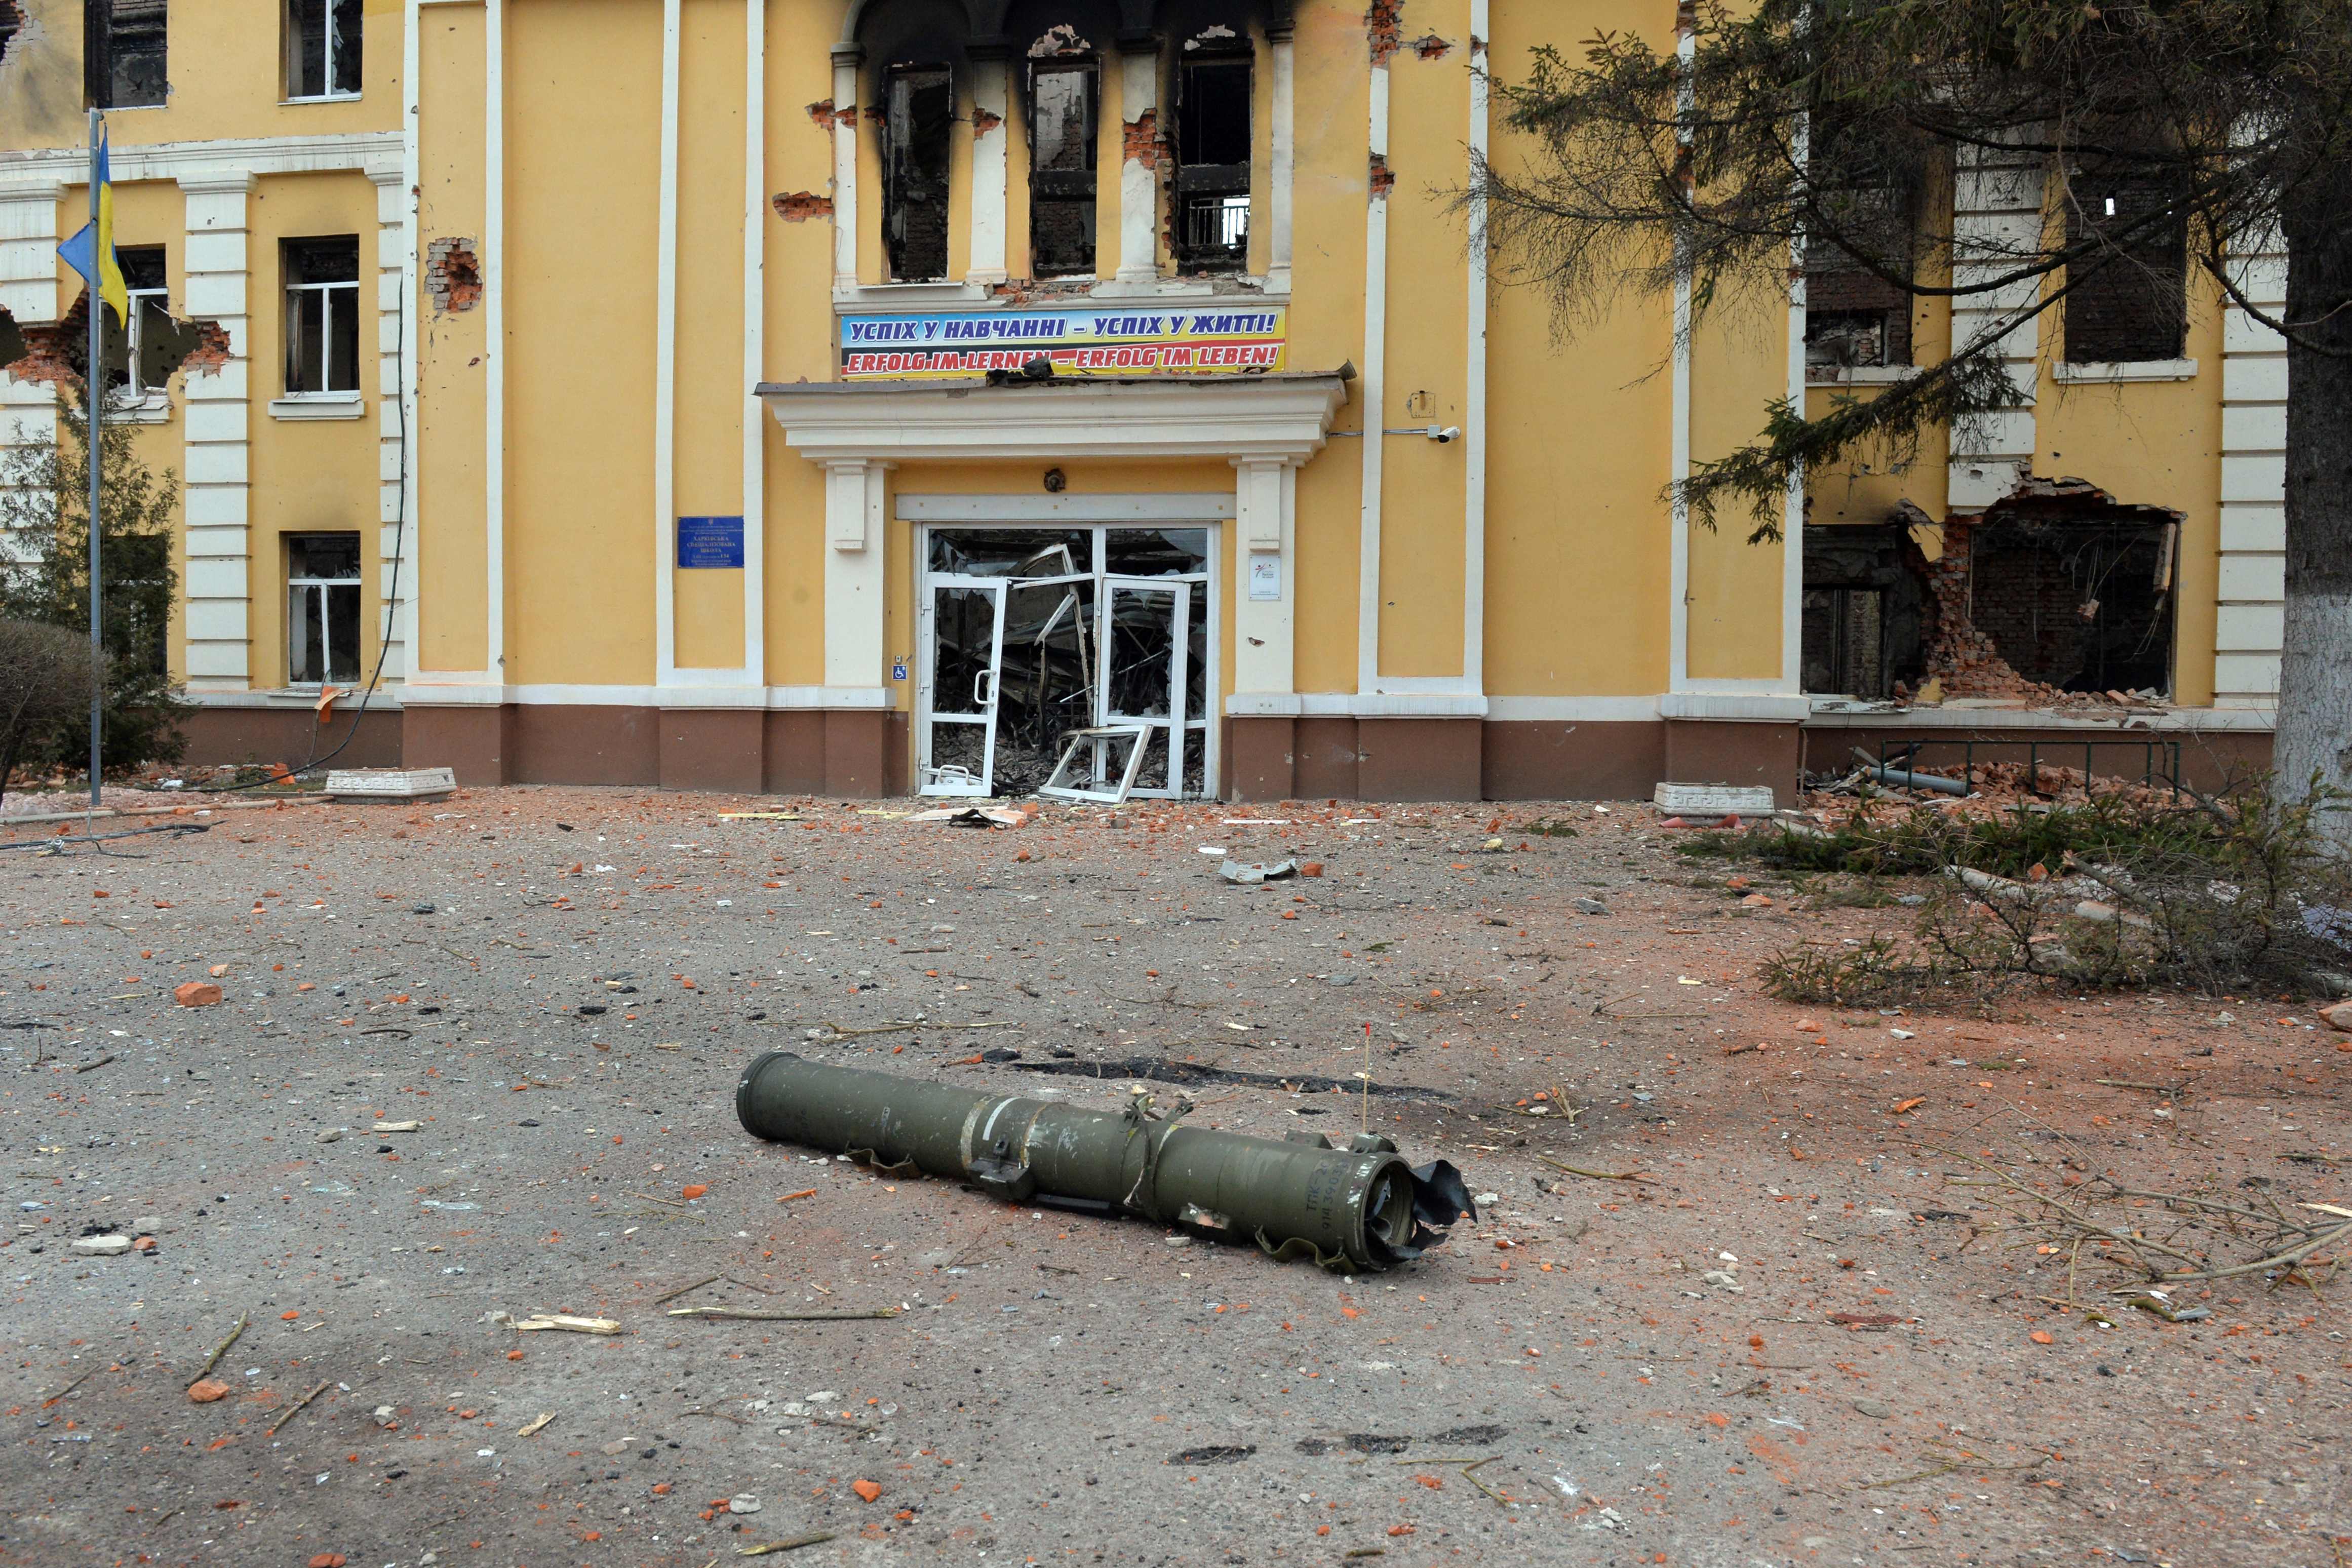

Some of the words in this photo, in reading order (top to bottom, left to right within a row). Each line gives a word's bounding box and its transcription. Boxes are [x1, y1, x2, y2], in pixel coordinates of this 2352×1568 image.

[851, 322, 918, 341] УСПІХ
[924, 321, 938, 339] У
[944, 319, 1066, 339] НАВЧАННІ
[1094, 317, 1163, 335] УСПІХ
[1170, 316, 1186, 334] У
[1190, 314, 1276, 333] ЖИТТІ!
[849, 354, 925, 372] ERFOLG
[931, 353, 960, 370] IM
[1076, 349, 1158, 367] ERFOLG
[1163, 348, 1192, 366] IM
[1199, 347, 1278, 365] LEBEN!
